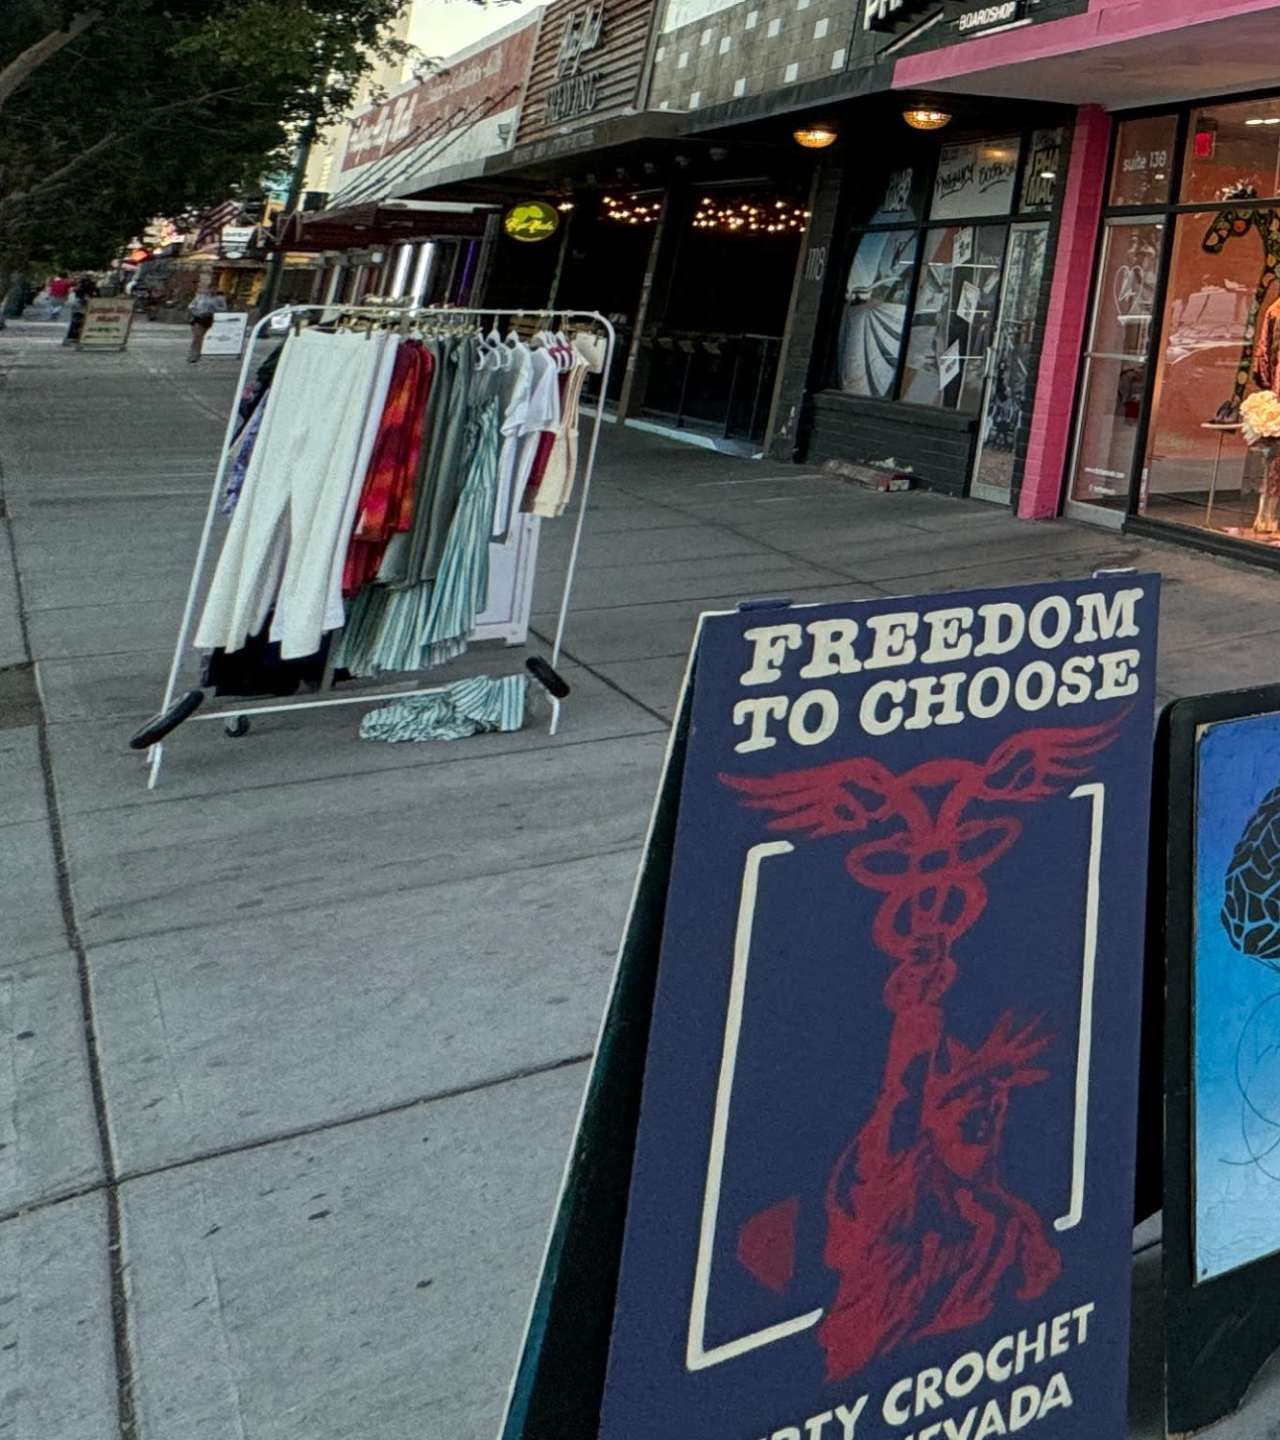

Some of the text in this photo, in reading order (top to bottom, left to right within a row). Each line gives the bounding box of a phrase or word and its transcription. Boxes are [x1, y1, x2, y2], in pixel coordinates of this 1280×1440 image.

[959, 1, 1017, 31] BOARDSHOP
[739, 587, 1145, 687] FREEDOM
[733, 648, 1140, 755] TO CHOOSE
[882, 1301, 1095, 1426] CROCHET
[903, 1371, 1074, 1440] EVADA
